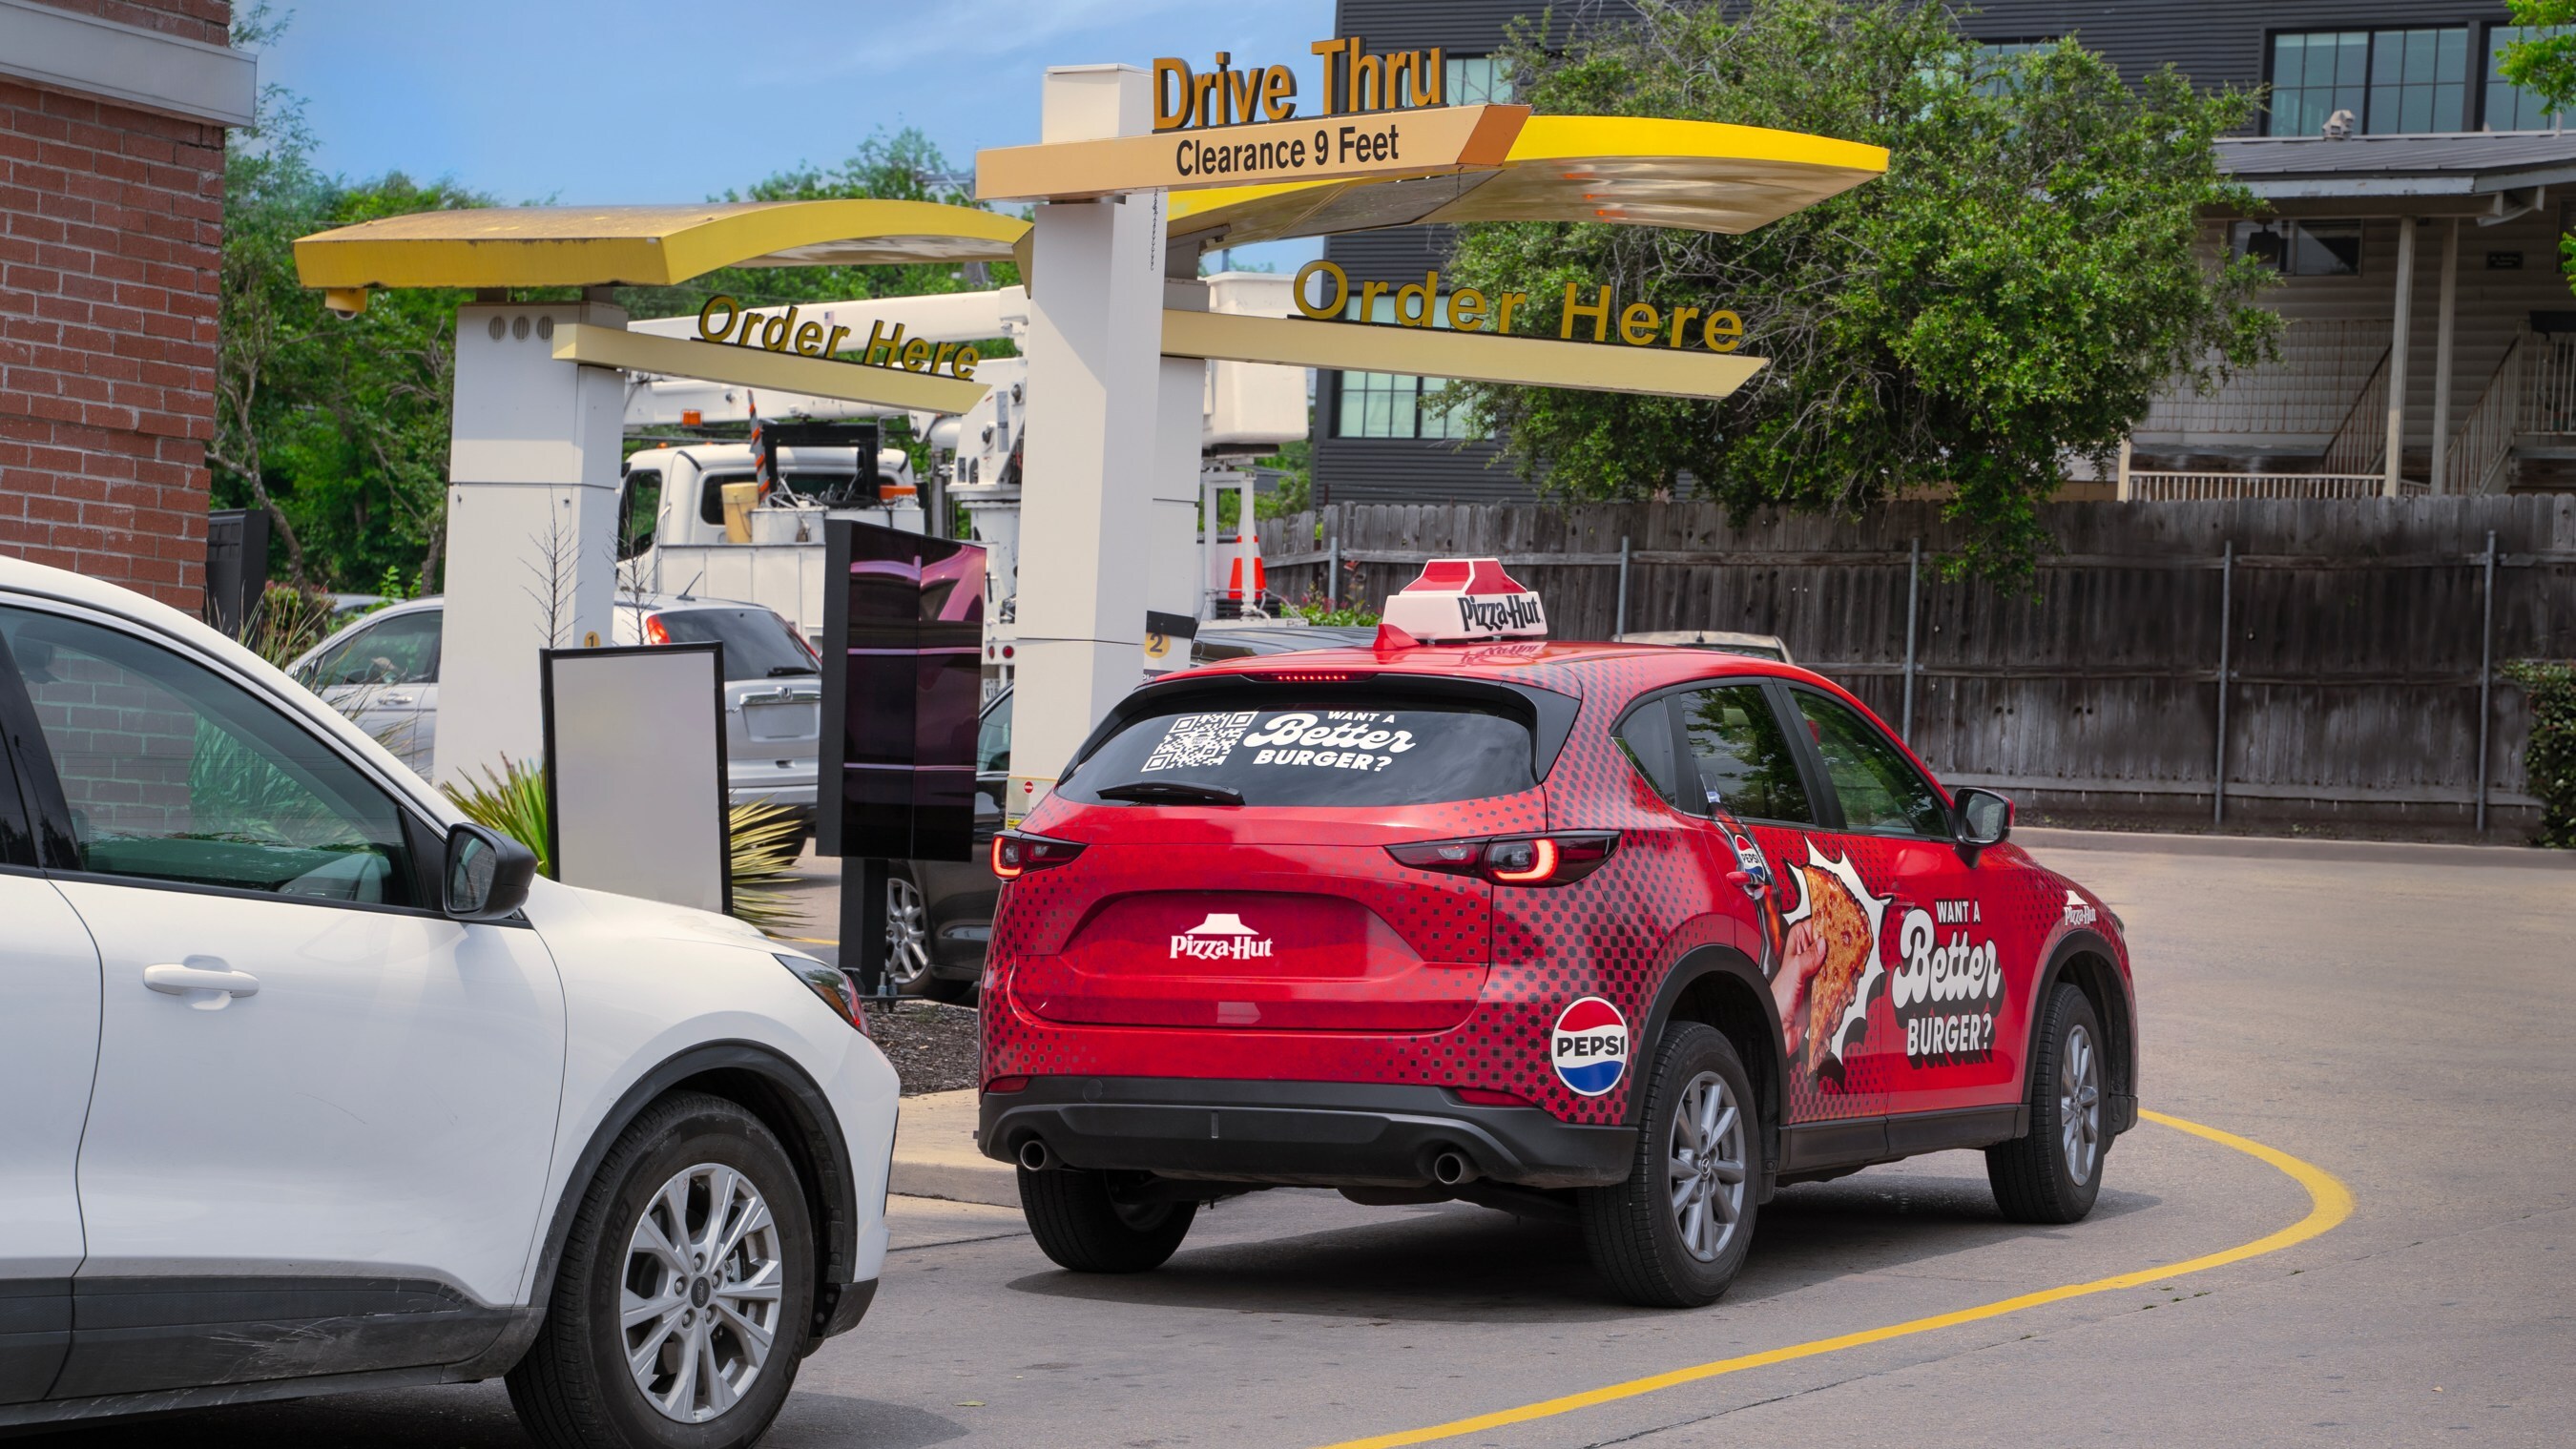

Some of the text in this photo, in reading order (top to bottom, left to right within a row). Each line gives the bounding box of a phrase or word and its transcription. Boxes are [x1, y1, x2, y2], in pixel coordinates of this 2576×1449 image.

[1153, 36, 1447, 129] Drive Thru
[1176, 124, 1399, 176] Clearance 9 Feet
[1293, 259, 1744, 353] Order Here
[698, 295, 980, 380] Order Here
[1457, 595, 1540, 631] Pizza Hut
[588, 634, 594, 648] 1
[1150, 632, 1163, 652] 2
[1327, 711, 1395, 723] WANT A
[1242, 713, 1416, 753] Better
[1252, 750, 1393, 772] BURGER?
[1936, 900, 1981, 922] WANT A
[2064, 906, 2083, 925] Pizza
[1170, 935, 1273, 960] Pizza Hut
[1892, 909, 2002, 1008] Better
[1557, 1035, 1625, 1057] PEPSI
[1907, 1013, 1992, 1056] BURGER?
